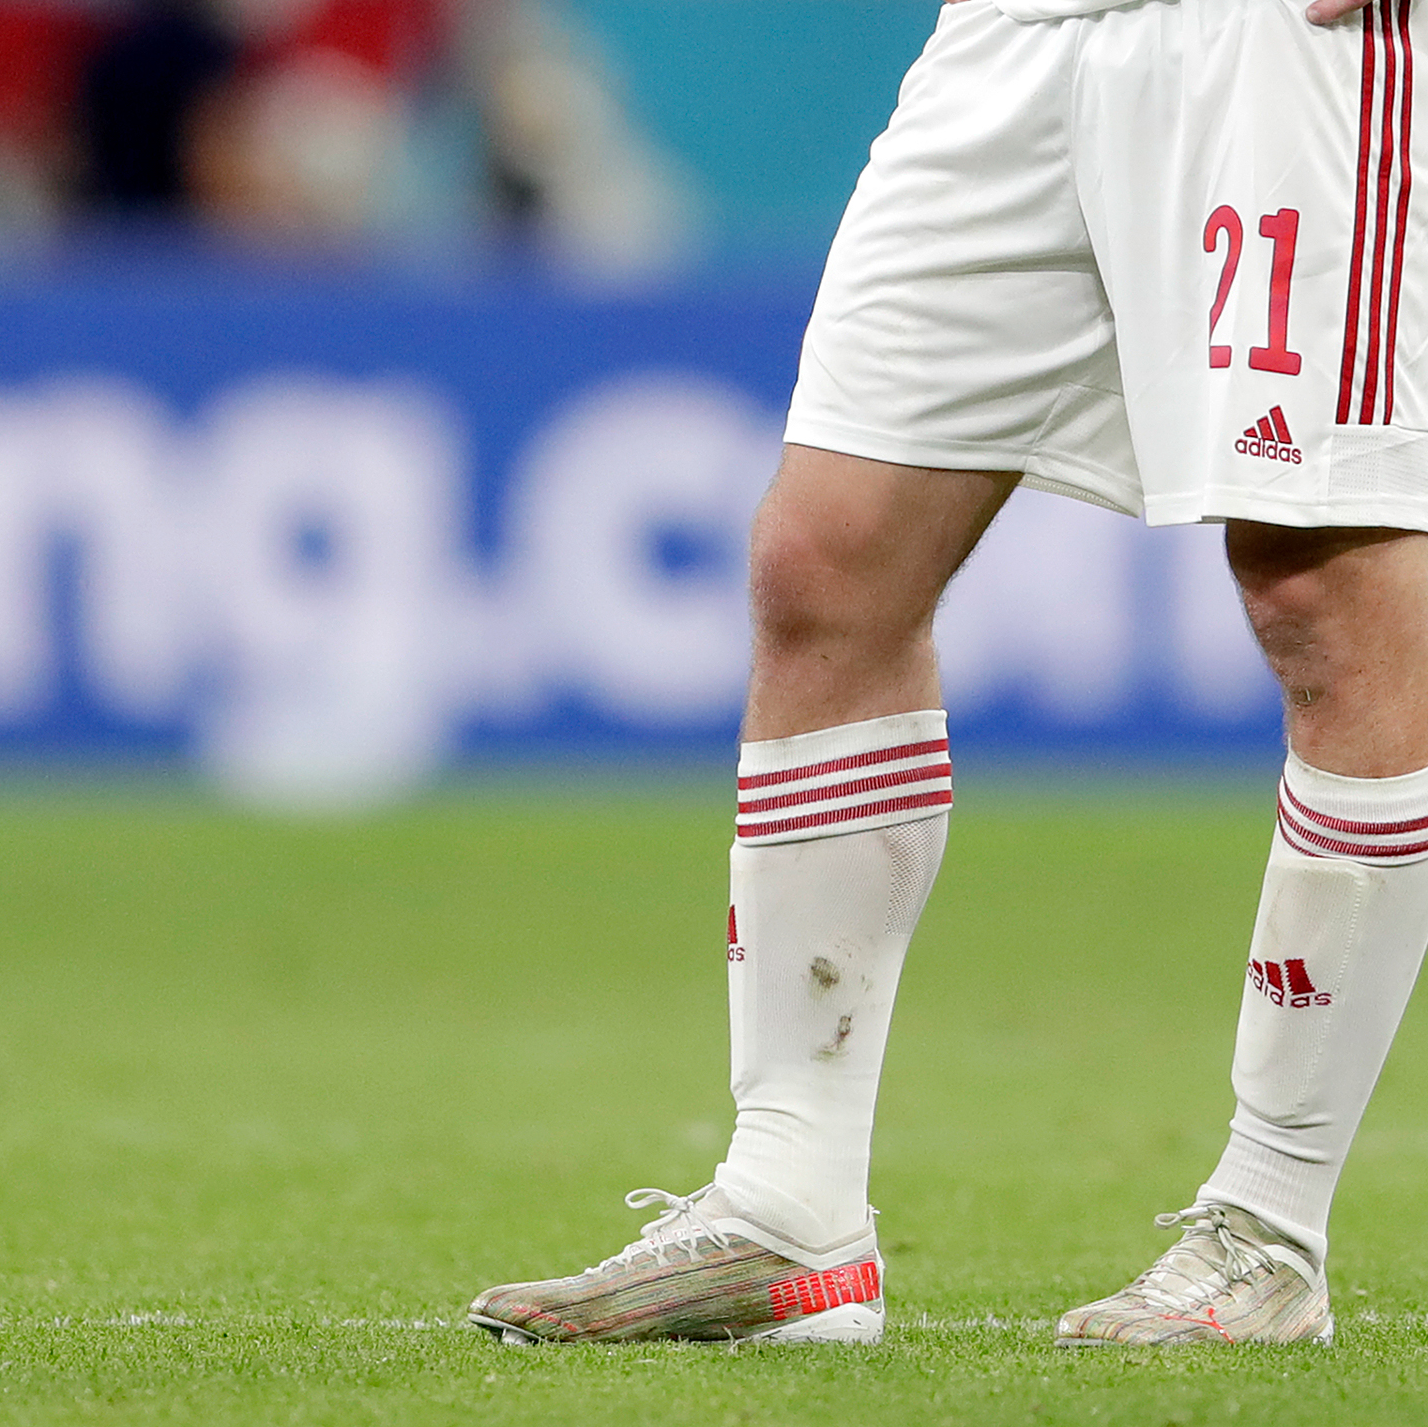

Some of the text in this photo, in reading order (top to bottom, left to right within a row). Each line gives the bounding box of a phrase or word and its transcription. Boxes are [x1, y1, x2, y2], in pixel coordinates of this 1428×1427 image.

[1203, 204, 1302, 376] 21
[1234, 437, 1303, 465] adidas
[767, 1261, 880, 1322] PUMA
